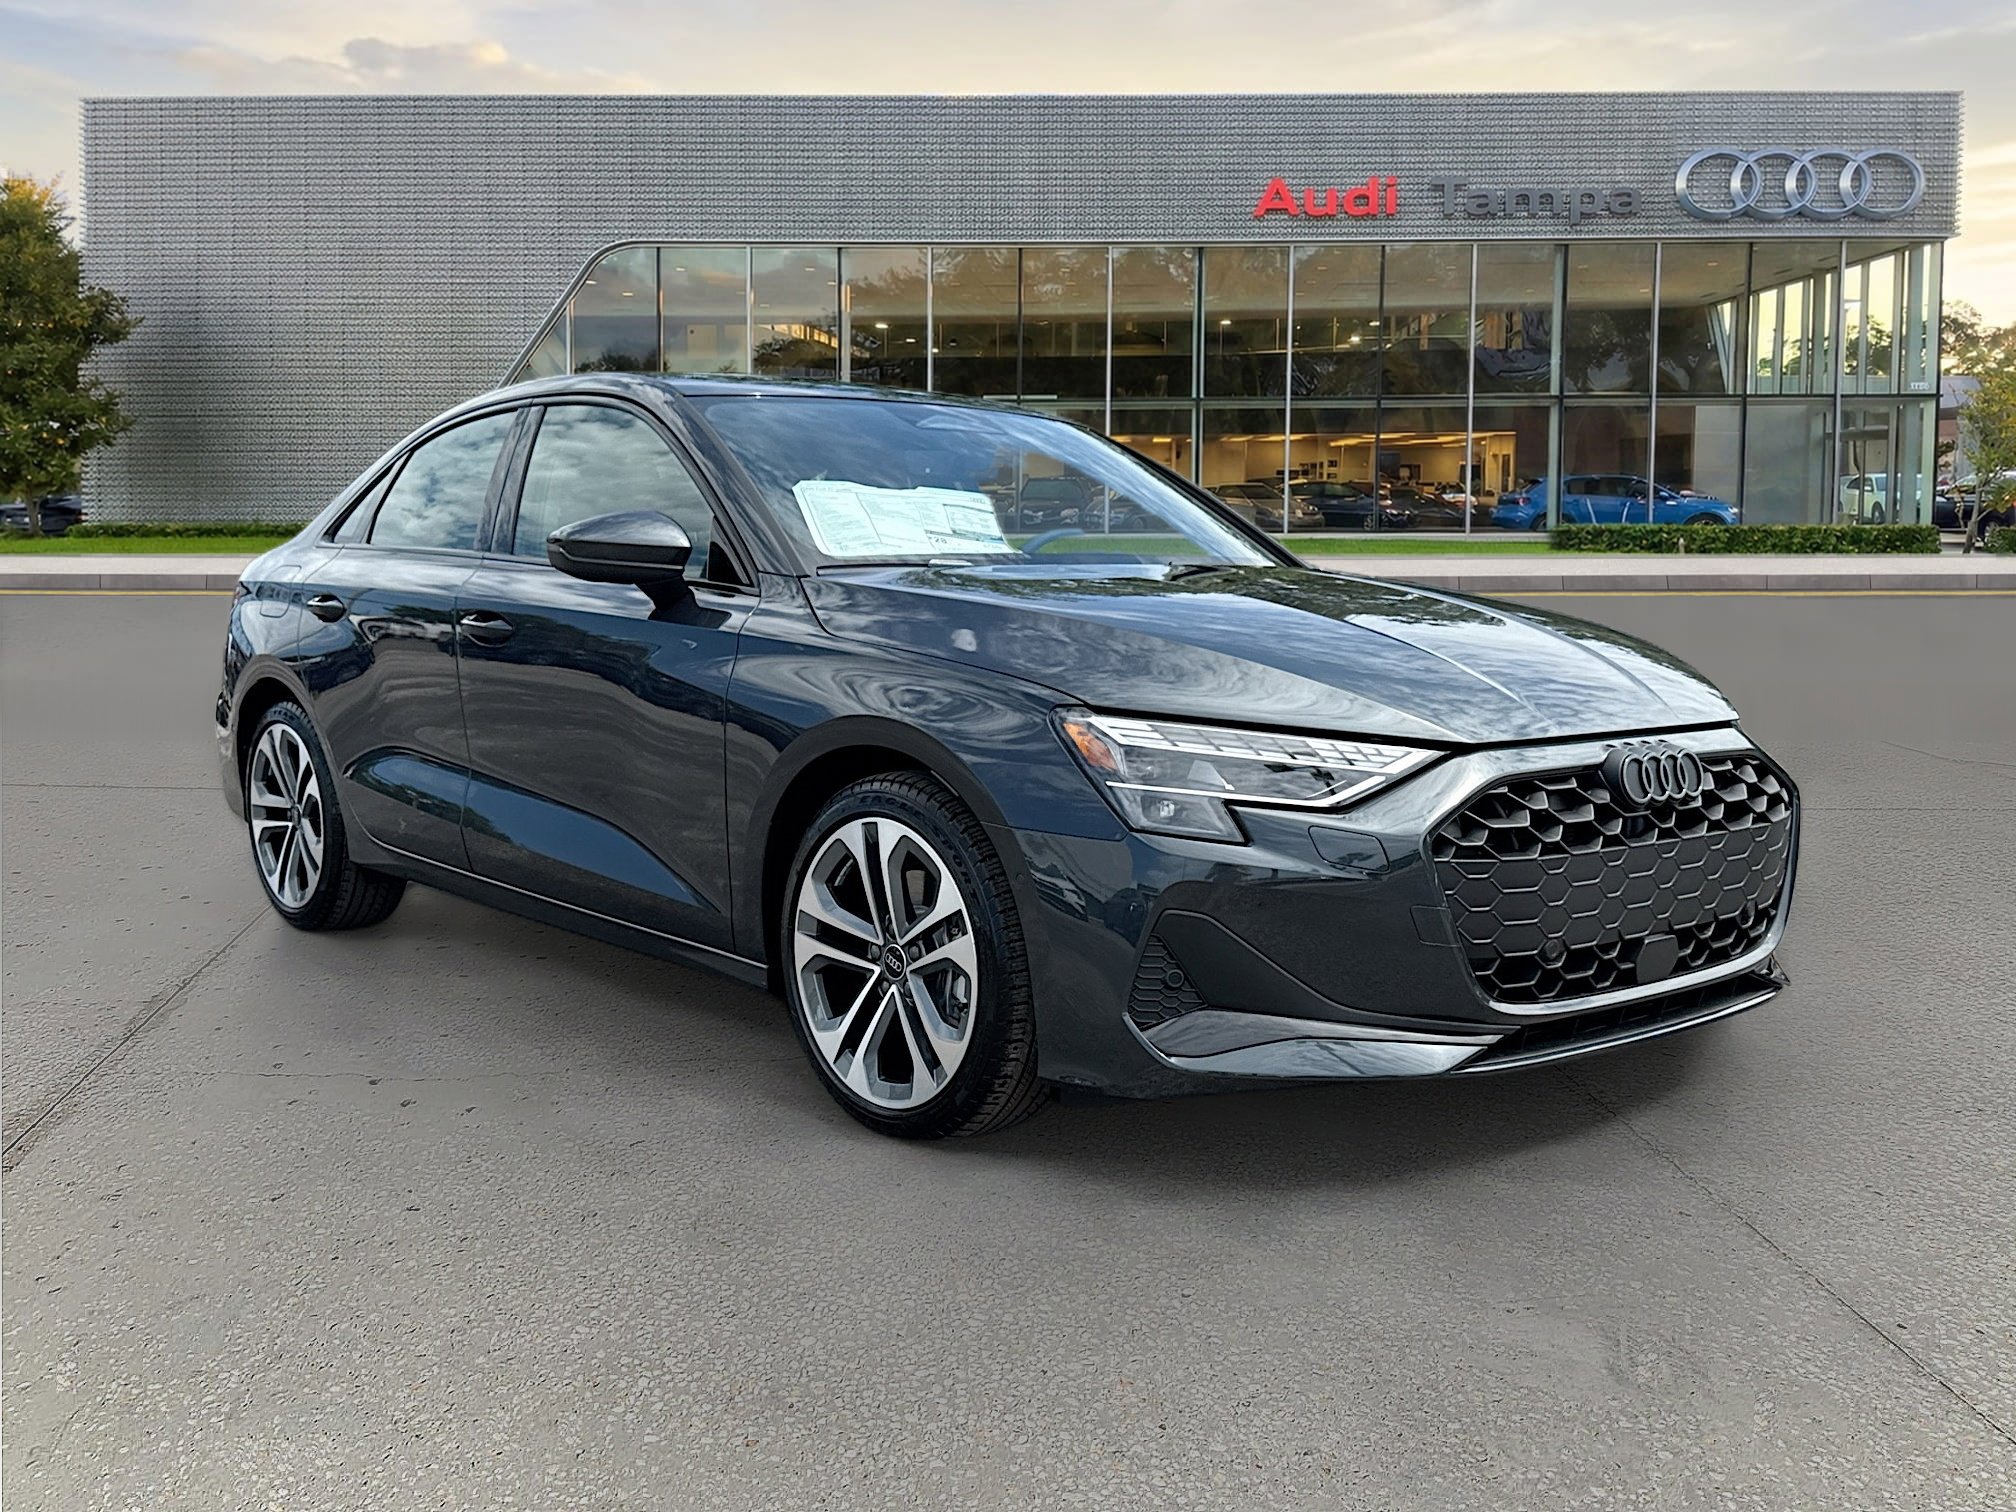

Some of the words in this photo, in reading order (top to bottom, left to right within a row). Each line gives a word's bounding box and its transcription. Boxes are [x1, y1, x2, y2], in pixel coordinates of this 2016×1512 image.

[1253, 176, 1398, 217] Audi
[1430, 176, 1643, 226] Tampa
[860, 796, 925, 818] EAGLE
